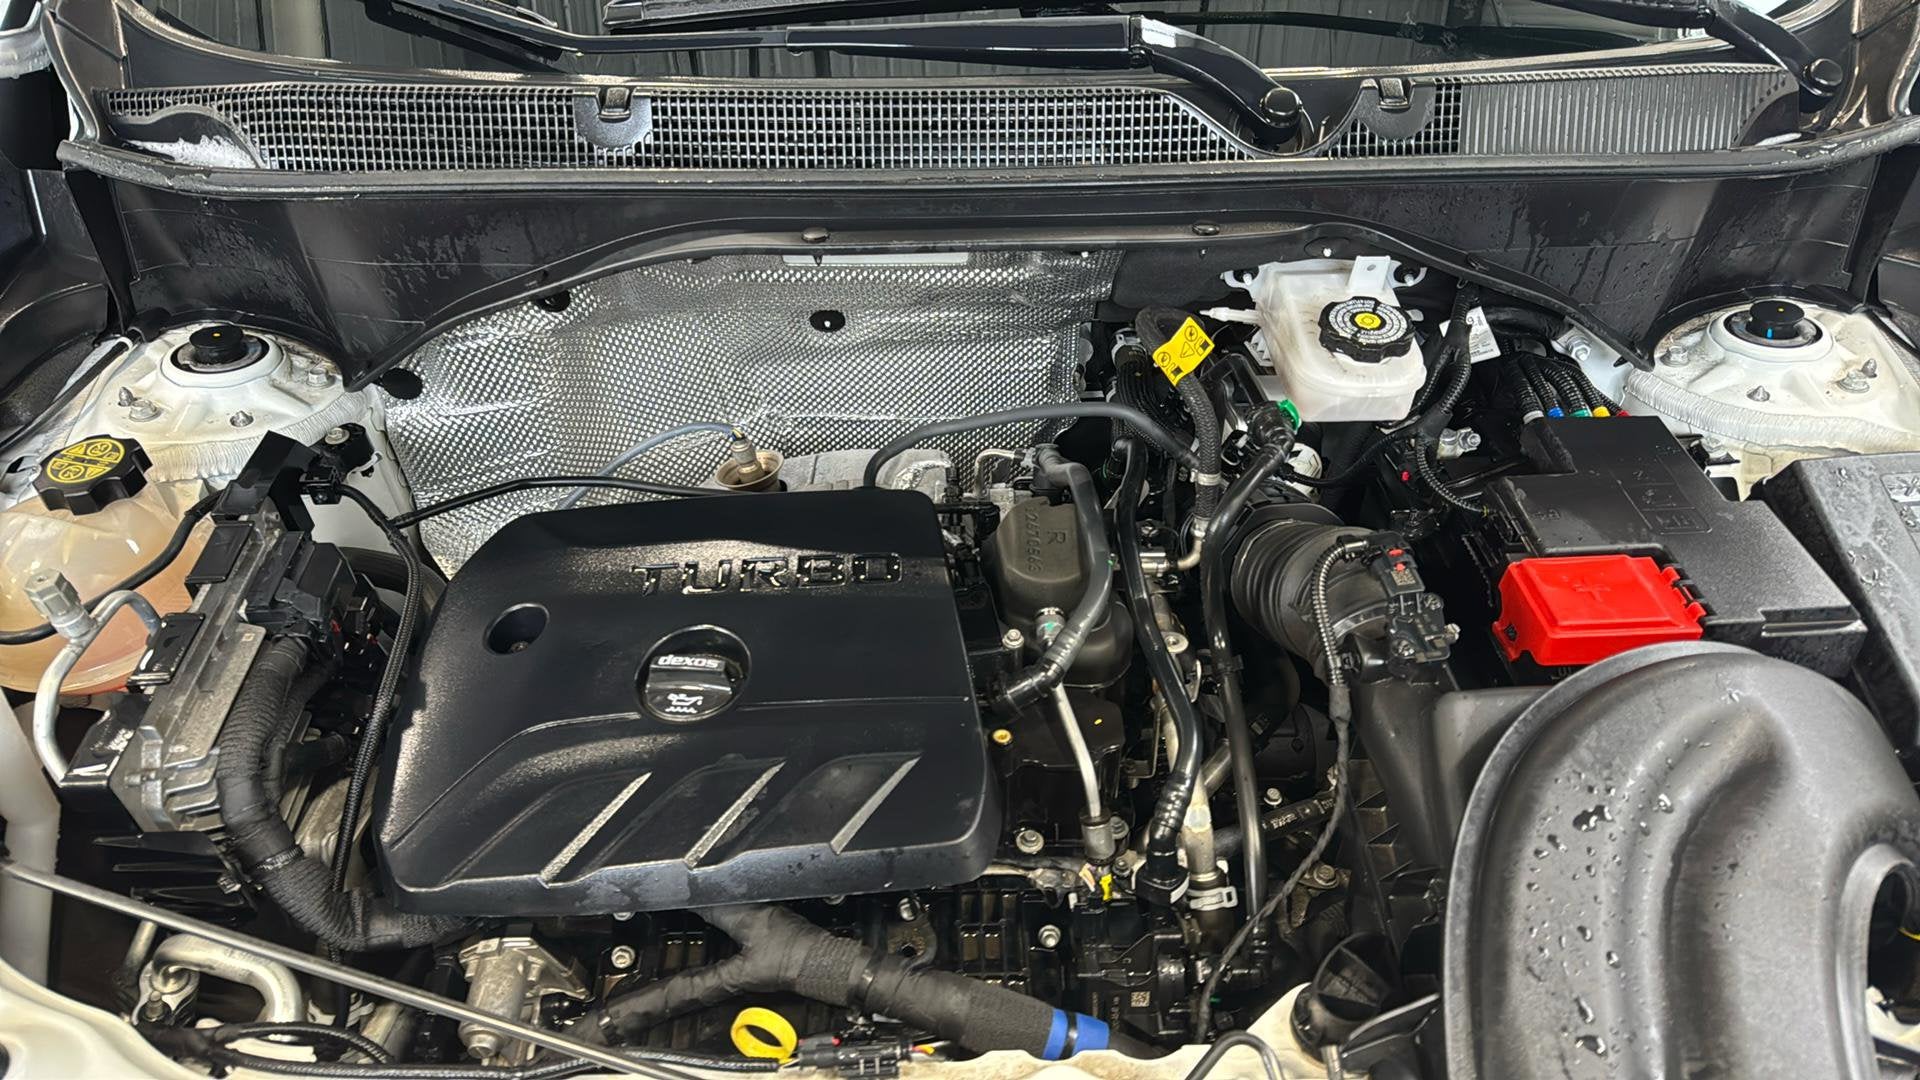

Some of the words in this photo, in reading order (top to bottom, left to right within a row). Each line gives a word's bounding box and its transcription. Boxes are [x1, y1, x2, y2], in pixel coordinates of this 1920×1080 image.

[1048, 531, 1066, 545] R
[631, 552, 902, 596] TURBO
[657, 653, 720, 669] dexos
